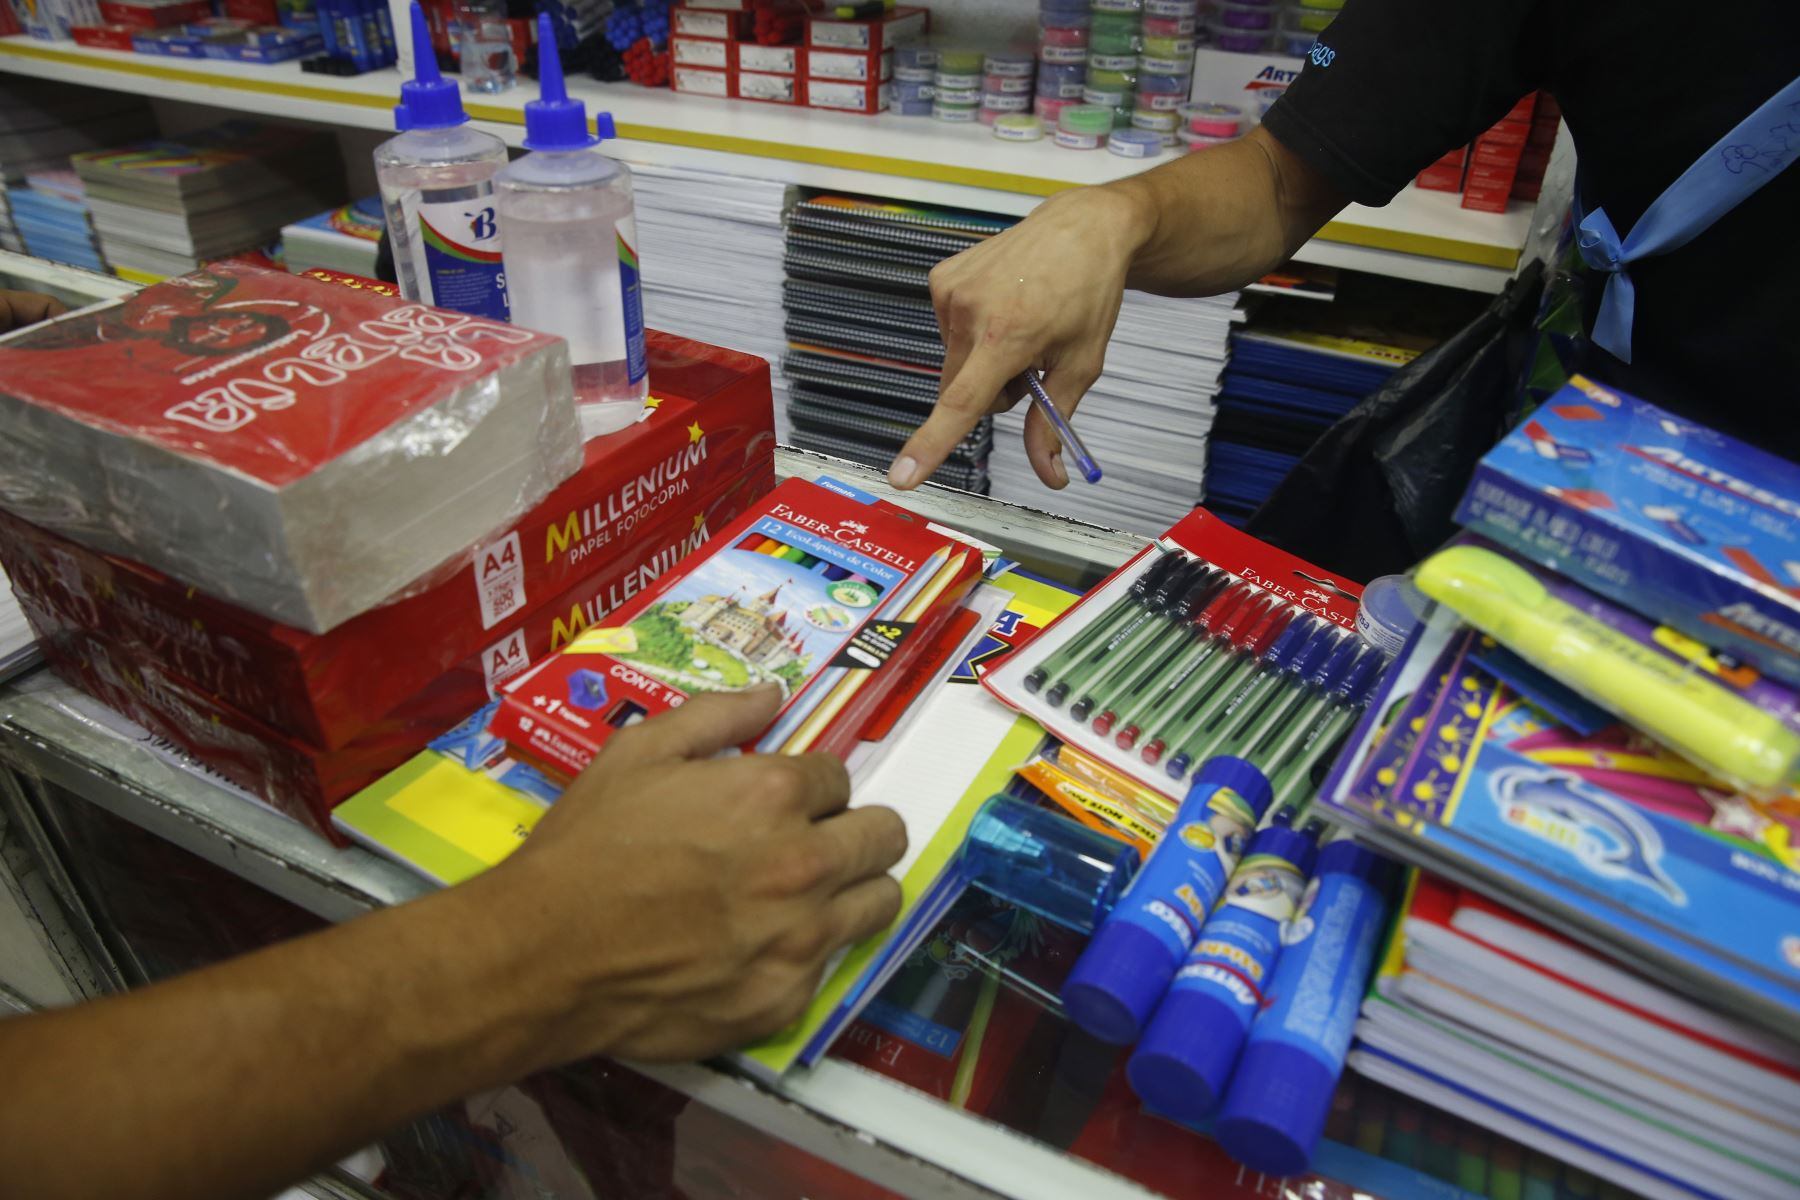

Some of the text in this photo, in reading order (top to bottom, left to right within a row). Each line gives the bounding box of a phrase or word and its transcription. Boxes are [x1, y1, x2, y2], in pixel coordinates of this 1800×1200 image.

[1256, 65, 1300, 81] ART
[164, 304, 472, 433] BIBLIA
[400, 320, 534, 372] LA
[546, 435, 708, 564] MILLENIUM
[821, 481, 856, 498] Formato
[570, 478, 690, 565] PAPEL FOTOCOPIA
[769, 503, 915, 572] FABER-CASTELL
[483, 541, 517, 579] A4
[761, 521, 783, 535] 12
[846, 554, 862, 566] de
[862, 559, 895, 580] Color
[550, 522, 711, 652] MILLENIUM
[1239, 567, 1356, 629] FABER-CAST
[875, 624, 902, 640] +2
[491, 636, 520, 675] A4
[609, 663, 661, 697] CONT.
[532, 695, 562, 714] +1
[1089, 801, 1124, 820] NOTE
